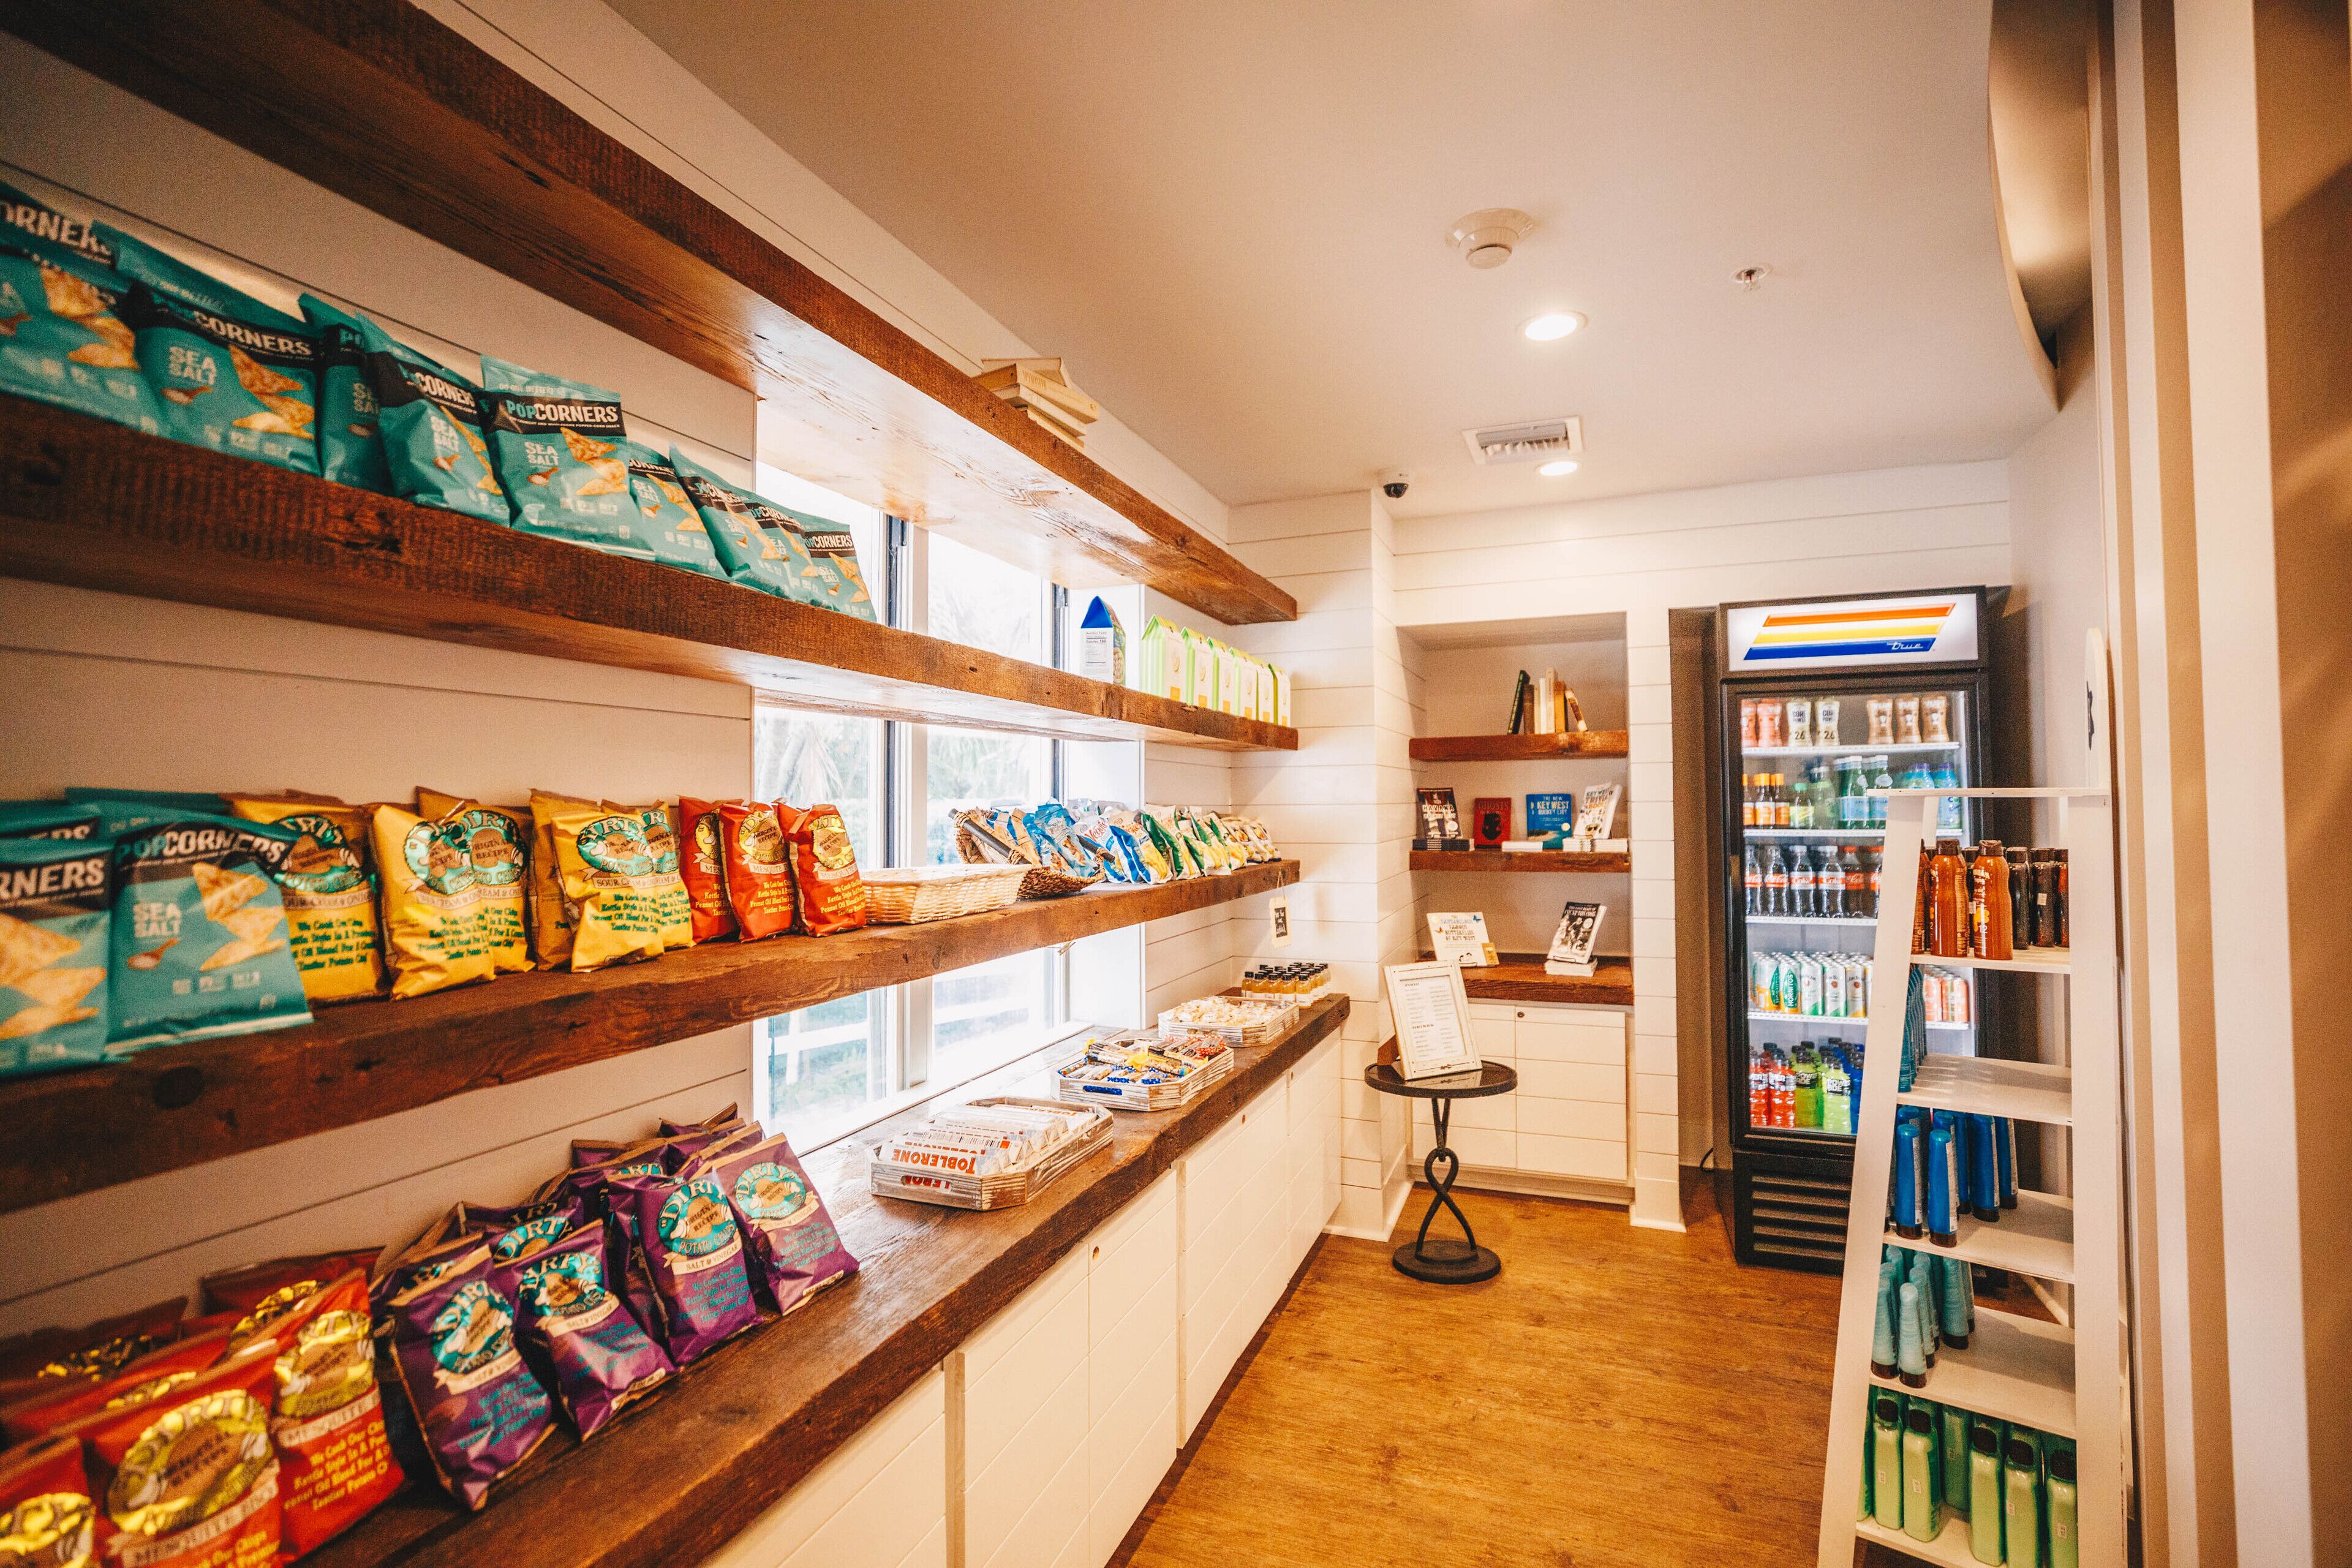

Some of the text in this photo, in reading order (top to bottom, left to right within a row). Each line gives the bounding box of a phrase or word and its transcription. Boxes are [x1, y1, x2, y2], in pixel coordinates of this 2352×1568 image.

[169, 345, 216, 369] SEA
[169, 363, 217, 385] SALT
[506, 399, 619, 423] POPCORNERS
[524, 441, 558, 456] SEA
[527, 453, 559, 466] SALT
[1795, 731, 1805, 740] 26
[1824, 730, 1835, 740] 26
[1537, 801, 1569, 809] KEY WEST
[596, 878, 619, 888] SOUR
[132, 902, 182, 920] SEA
[132, 919, 181, 938] SALT
[892, 1148, 976, 1174] TOBLERONE
[736, 1163, 791, 1197] DIRTY
[693, 1211, 720, 1232] RECIPE
[679, 1240, 713, 1254] POTATO
[685, 1259, 705, 1271] SALT
